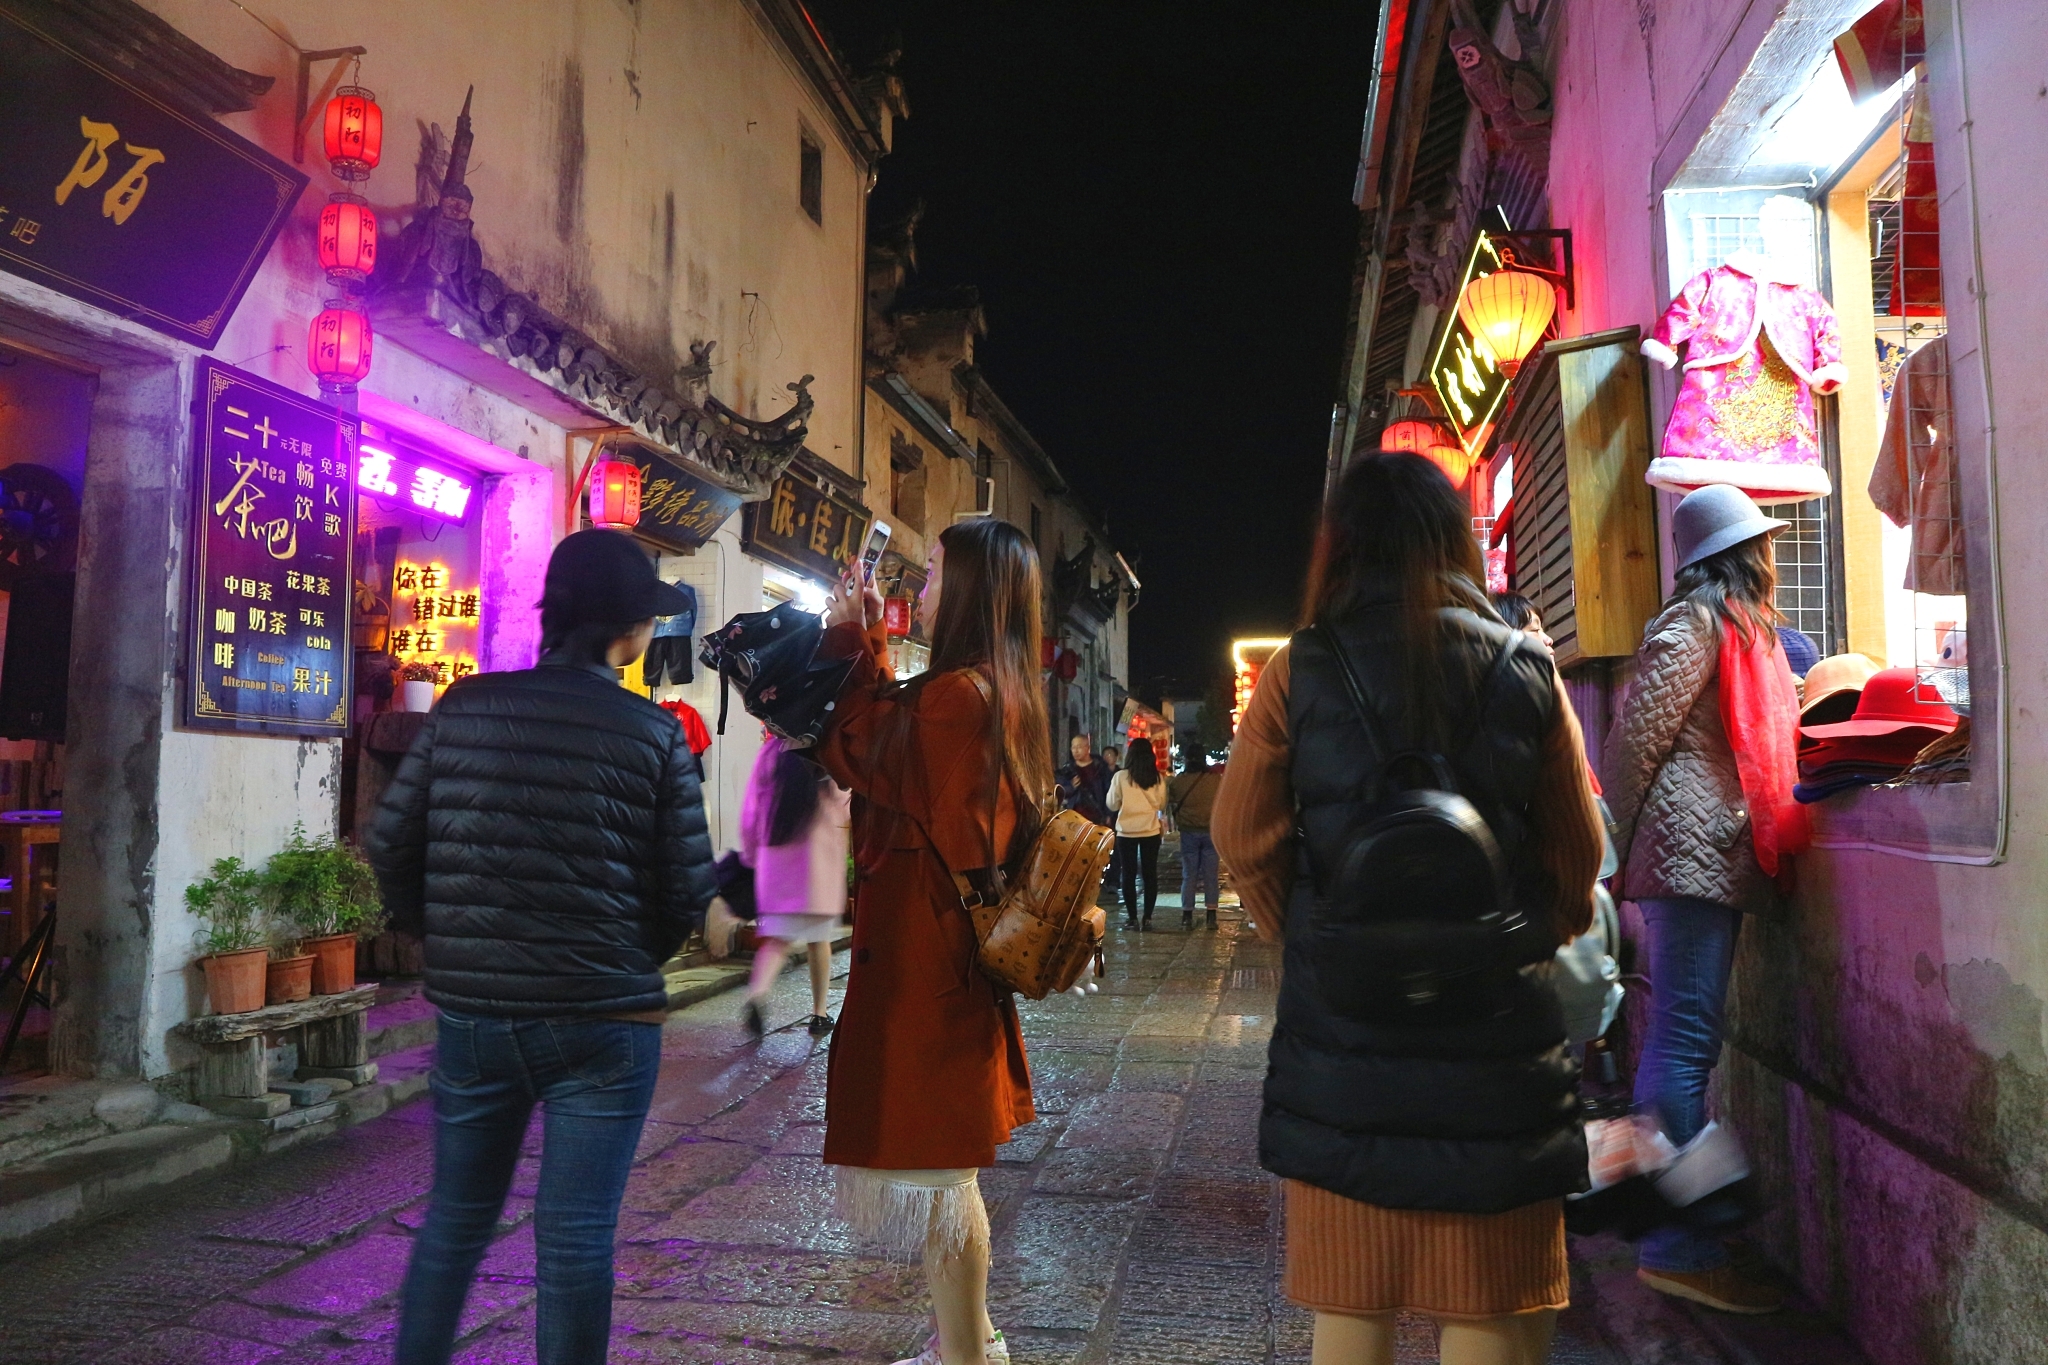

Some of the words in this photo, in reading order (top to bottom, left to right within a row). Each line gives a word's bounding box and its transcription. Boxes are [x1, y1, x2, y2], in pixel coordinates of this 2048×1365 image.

[345, 102, 361, 143] 初陌
[55, 115, 165, 225] 陌
[260, 460, 286, 484] Tea
[224, 575, 273, 601] 中国茶
[286, 570, 331, 596] 花果茶
[396, 566, 441, 590] 你在
[299, 608, 325, 628] 可乐
[413, 594, 480, 620] 错过谁
[249, 607, 287, 635] 奶茶
[306, 635, 331, 651] cola
[391, 629, 437, 652] 谁在
[222, 675, 267, 691] Afternoon
[271, 681, 286, 694] Tea
[293, 668, 332, 696] 果汁
